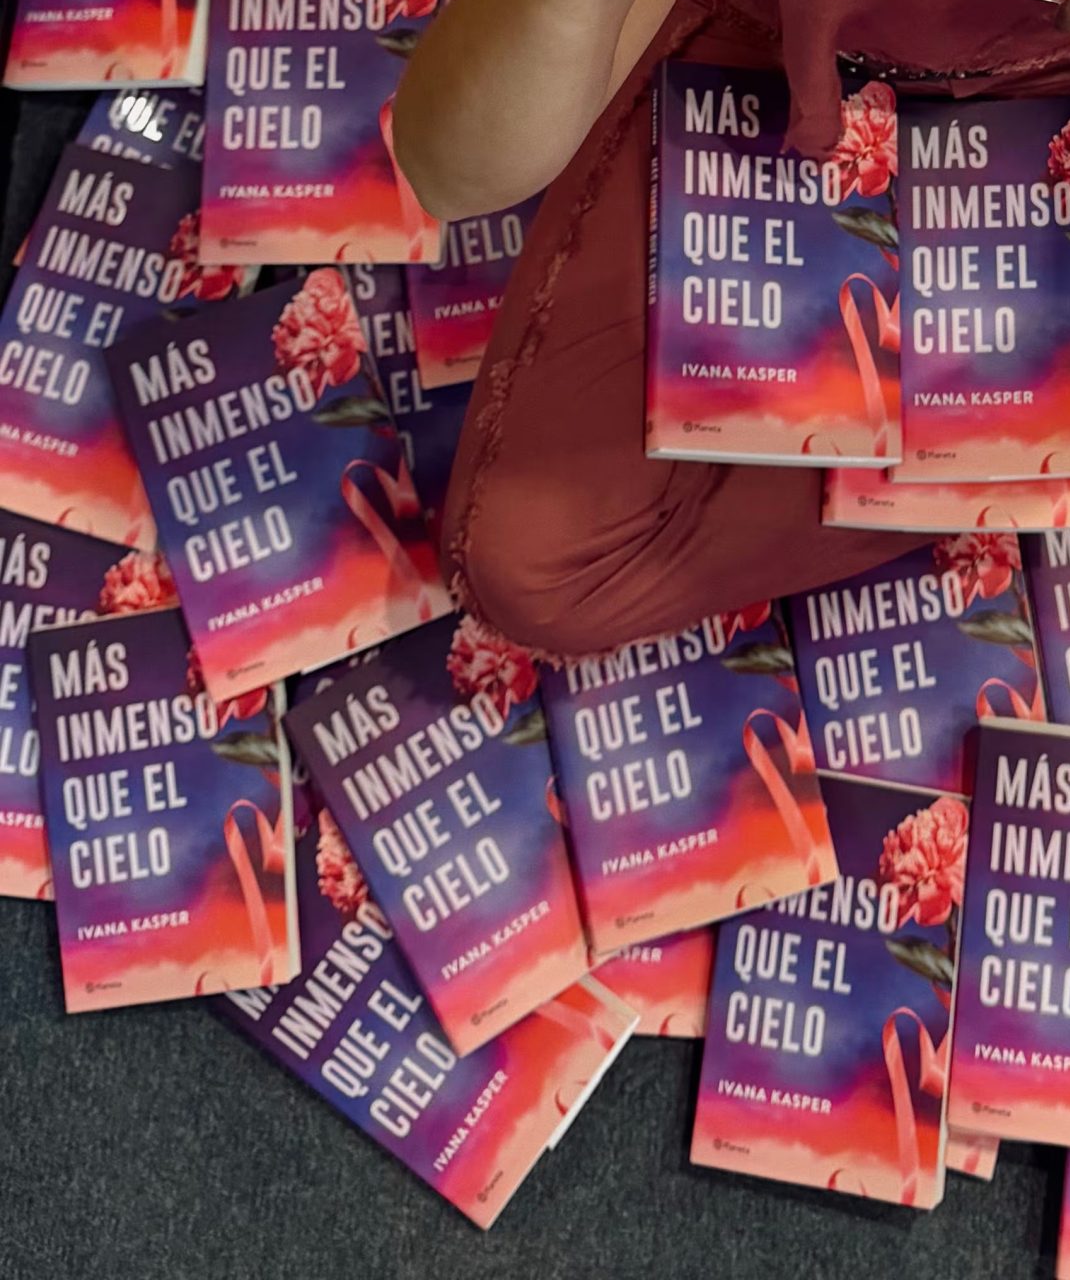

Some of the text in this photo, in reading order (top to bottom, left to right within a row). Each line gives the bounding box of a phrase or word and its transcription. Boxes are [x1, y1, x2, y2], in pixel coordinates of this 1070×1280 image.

[226, 46, 345, 96] QUE EL
[224, 105, 322, 151] CIELO
[686, 85, 760, 138] MÁS
[912, 119, 987, 169] MÁS
[220, 184, 334, 198] IVANA KASPER
[685, 149, 841, 206] INMENSO
[684, 212, 804, 266] QUE EL
[913, 243, 1037, 298] QUE EL
[683, 275, 783, 330] CIELO
[914, 305, 1016, 354] CIELO
[130, 340, 215, 403] MÁS
[681, 362, 798, 382] IVANA KASPER
[914, 388, 1033, 406] IVANA KASPER
[148, 364, 315, 462] INMENSO
[166, 441, 297, 525] QUE EL
[184, 505, 293, 581] CIELO
[807, 568, 964, 640] INMENSO
[51, 640, 128, 697] MÁS
[58, 689, 217, 760] INMENSO
[314, 687, 399, 763] MÁS
[343, 688, 503, 818] INMENSO
[63, 762, 186, 830] QUE EL
[587, 749, 692, 821] CIELO
[373, 772, 501, 876] QUE EL
[70, 827, 170, 888] CIELO
[402, 836, 510, 930] CIELO
[77, 908, 192, 941] IVANA KASPER
[985, 889, 1055, 946] QUE
[726, 990, 825, 1058] CIELO
[974, 1044, 1028, 1065] IVANA
[431, 1067, 509, 1174] IVANA KASPER
